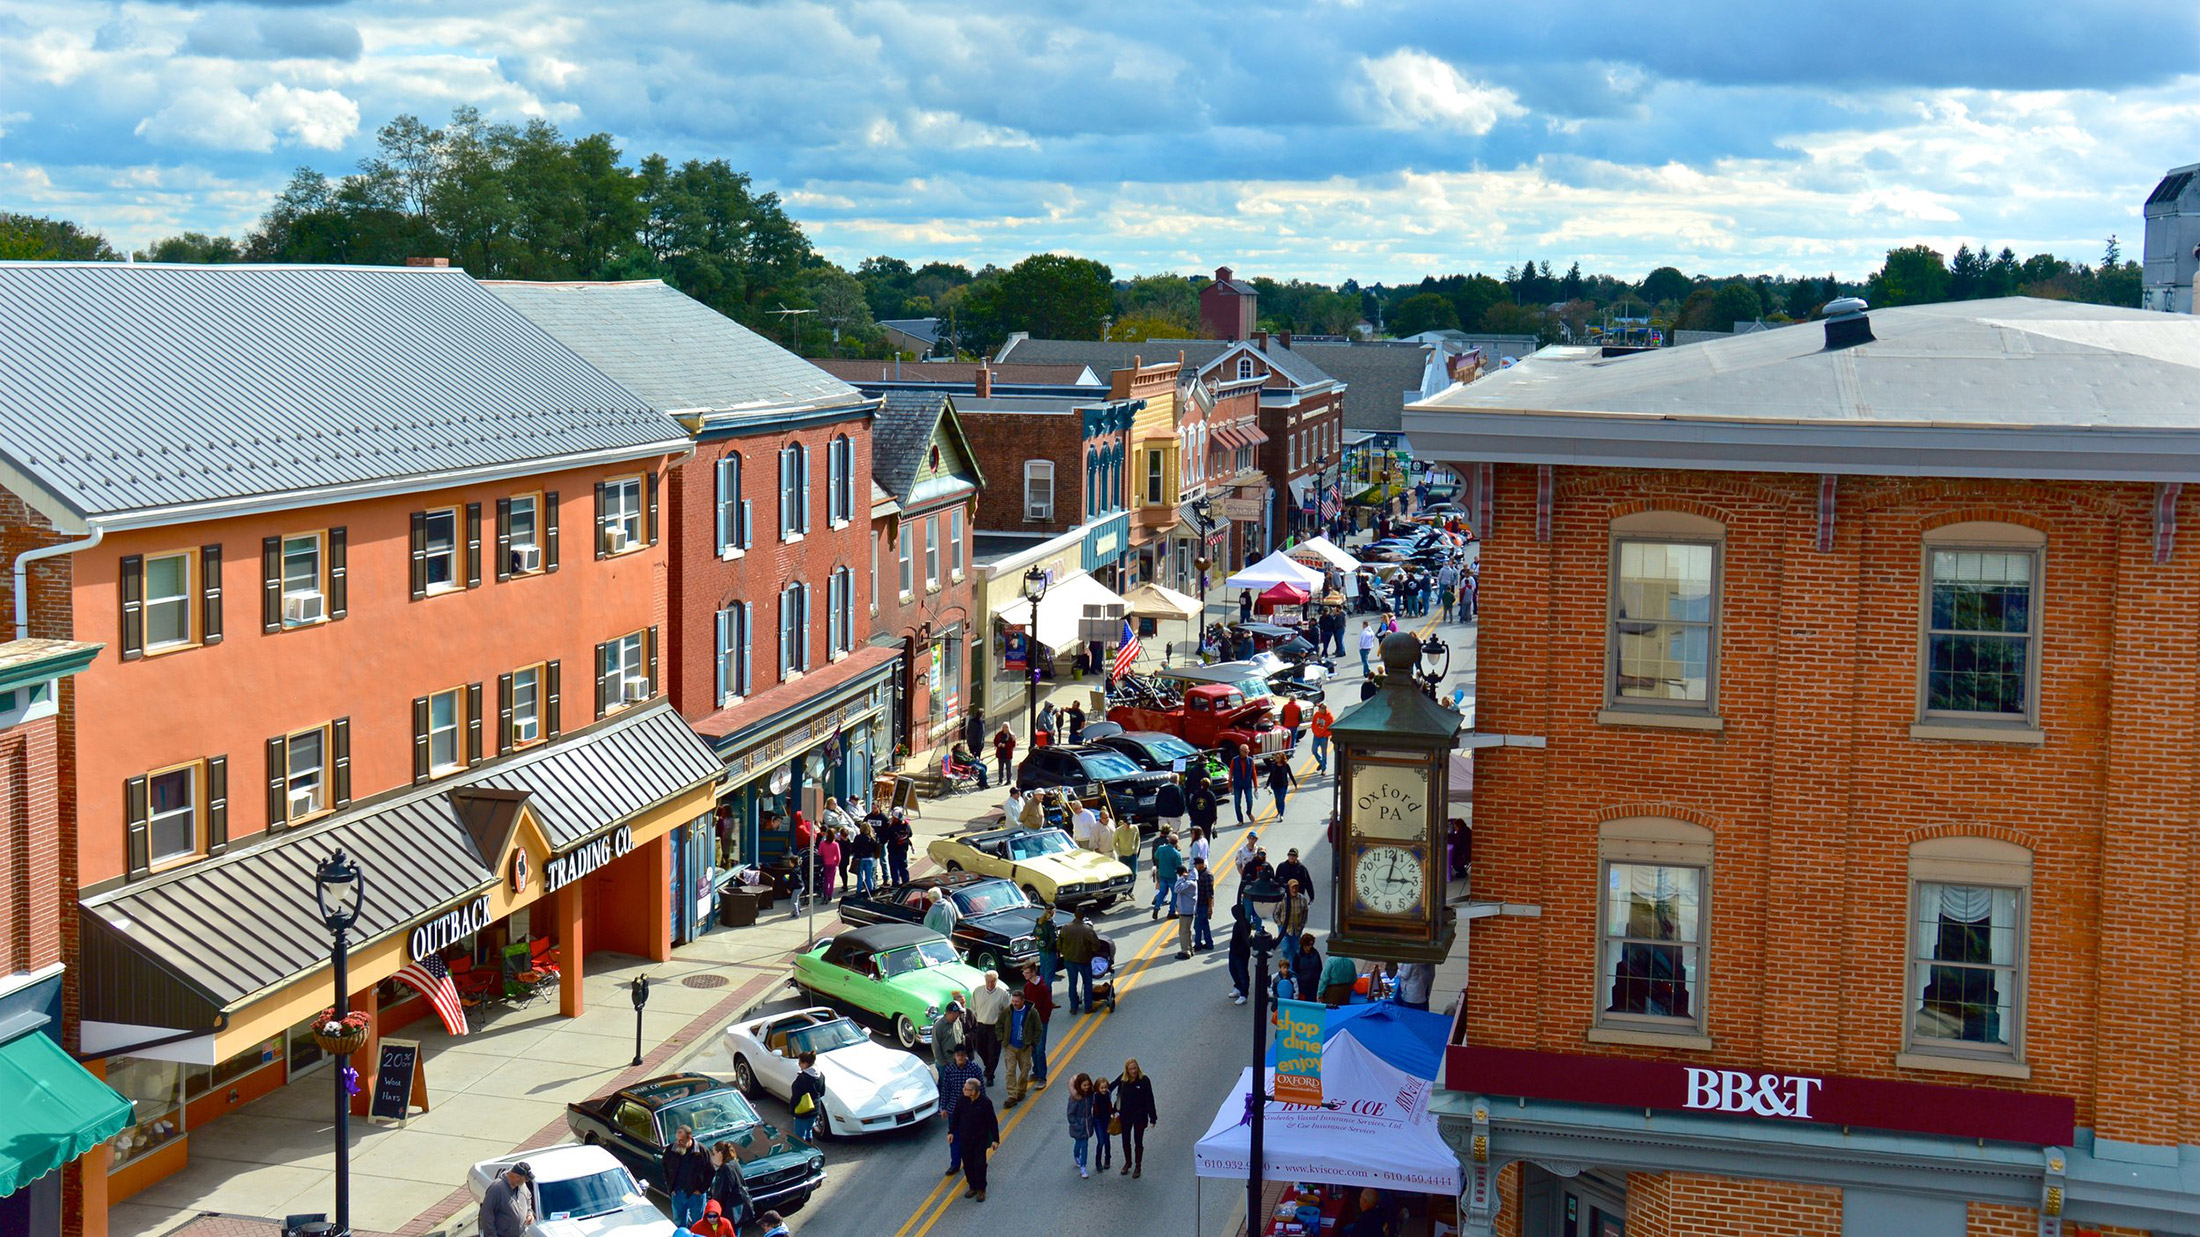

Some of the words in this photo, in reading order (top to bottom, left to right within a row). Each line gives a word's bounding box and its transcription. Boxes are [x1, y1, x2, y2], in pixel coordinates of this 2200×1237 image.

[1358, 784, 1422, 812] Oxford
[1380, 806, 1402, 820] PA
[411, 894, 493, 962] OUTBACK
[547, 835, 611, 893] TRADING
[615, 824, 635, 858] CO.
[1276, 1009, 1320, 1038] shop
[1283, 1028, 1322, 1053] dine
[1278, 1053, 1322, 1073] enjoy
[1277, 1074, 1320, 1088] OXFORD
[1682, 1067, 1822, 1119] BB&T
[1351, 1098, 1388, 1117] COE
[1311, 1122, 1347, 1131] Insurance
[1347, 1125, 1376, 1135] Services
[1320, 1114, 1355, 1124] Insurance
[1204, 1159, 1271, 1172] 610.932.90
[1285, 1162, 1368, 1178] www.kviscoe.com
[1383, 1171, 1452, 1186] 610.459.4444
